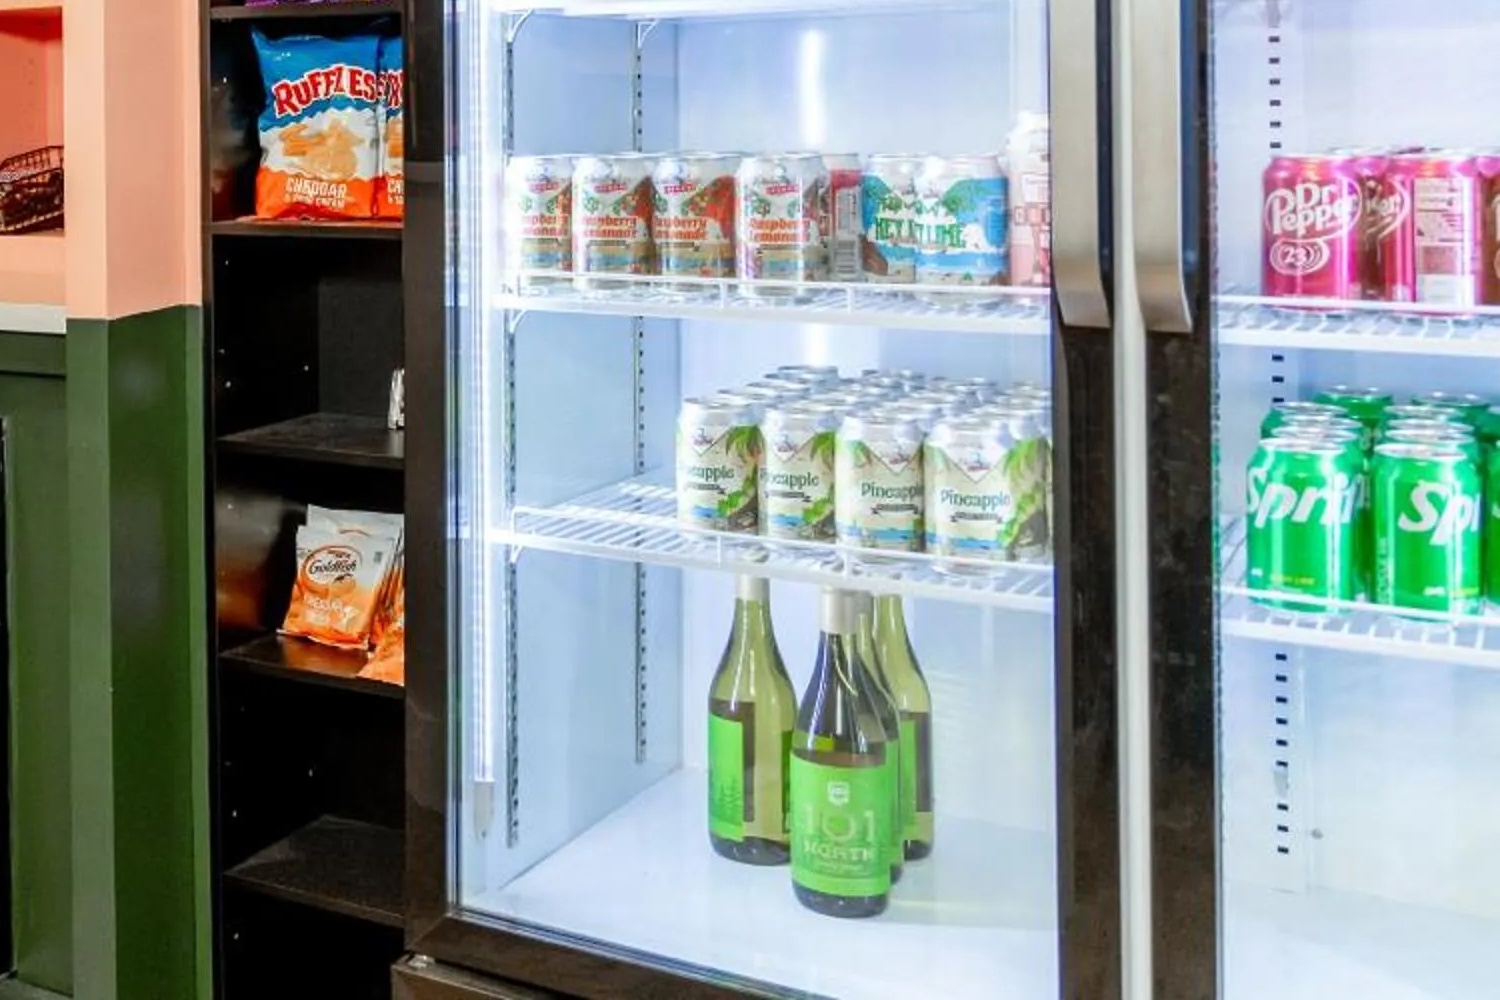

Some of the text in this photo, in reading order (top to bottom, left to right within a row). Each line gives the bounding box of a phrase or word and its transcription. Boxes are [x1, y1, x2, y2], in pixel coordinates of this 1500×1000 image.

[272, 63, 378, 119] RUFFLES
[286, 177, 347, 199] CHEDDAR
[1295, 181, 1338, 210] Dr
[940, 489, 1011, 511] Pineapple
[1247, 466, 1365, 529] Sprit
[308, 559, 357, 575] Goldfish
